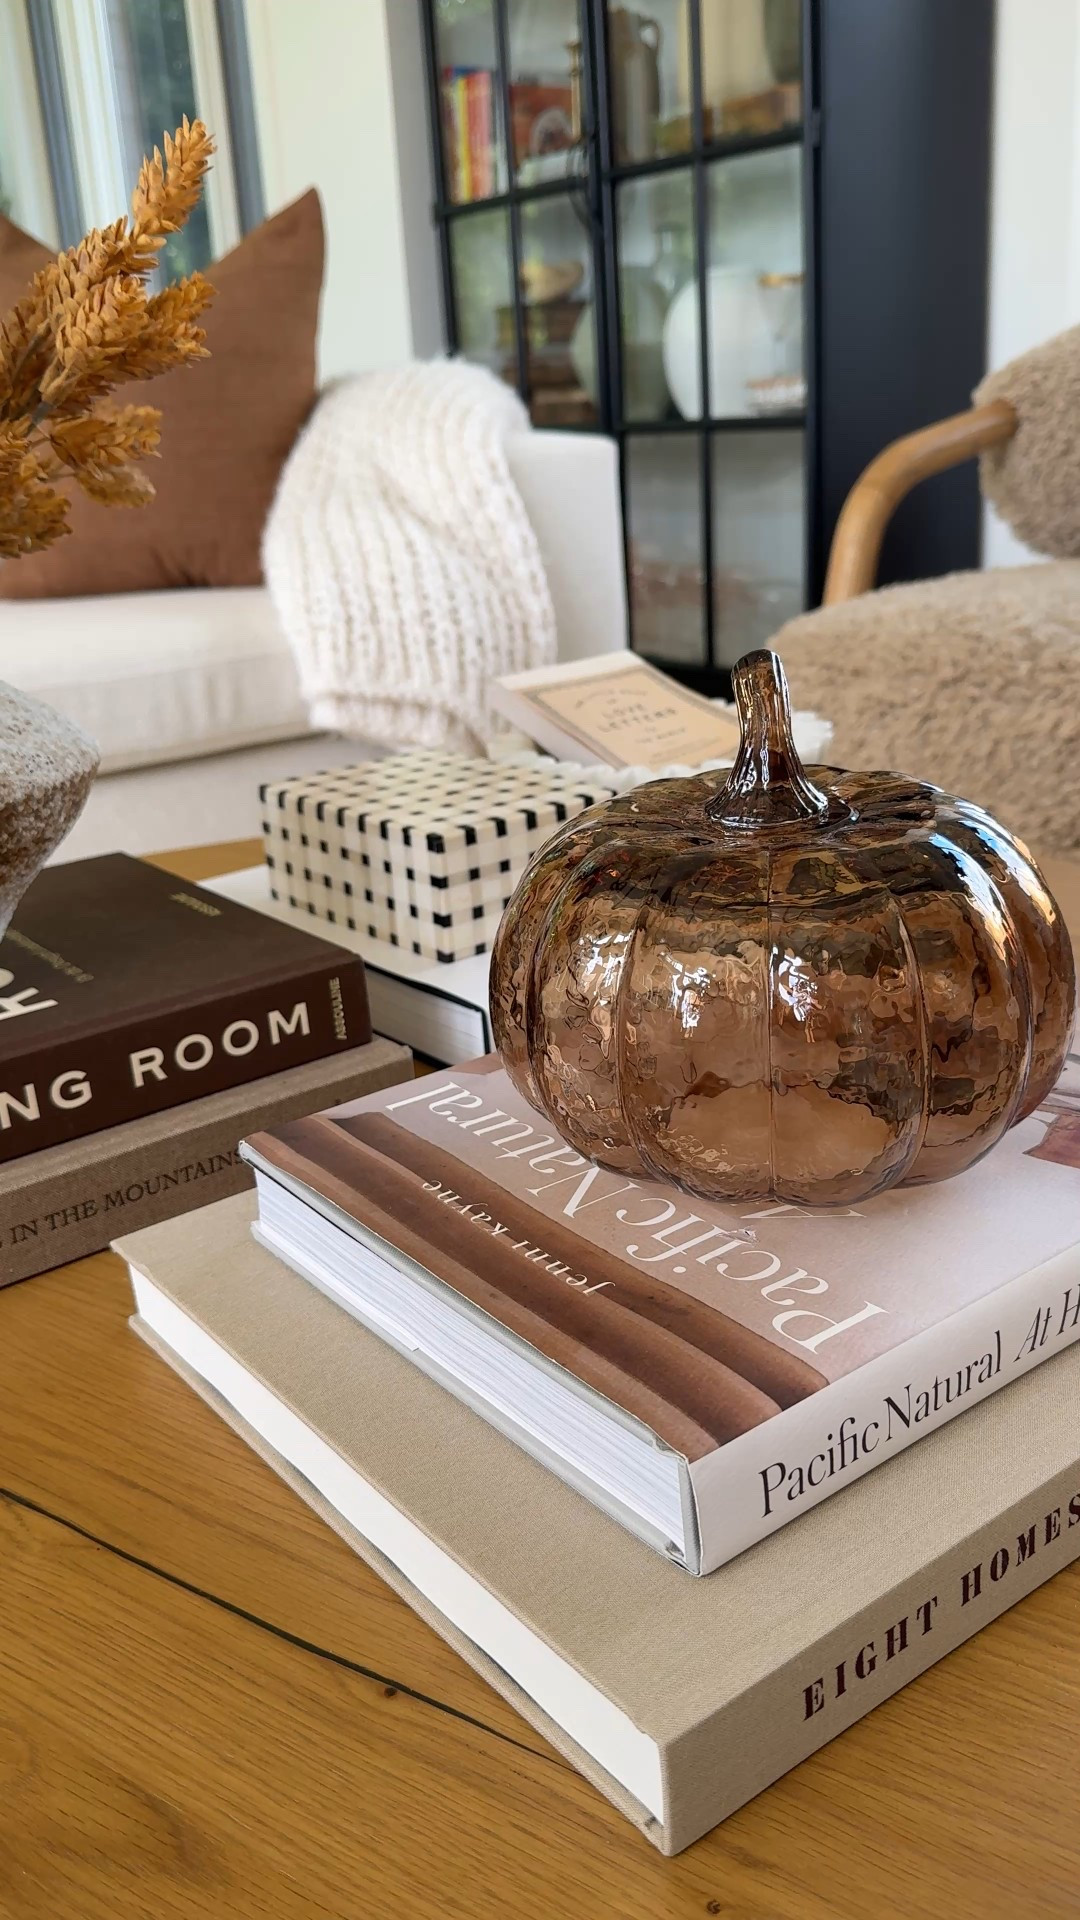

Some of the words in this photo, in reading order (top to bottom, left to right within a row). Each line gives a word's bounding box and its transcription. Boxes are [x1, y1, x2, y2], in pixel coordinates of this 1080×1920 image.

[0, 1070, 93, 1130] NG
[129, 1002, 311, 1089] ROOM
[10, 1219, 40, 1246] IN
[44, 1200, 100, 1231] THE
[104, 1151, 243, 1212] MOUNTAINS
[386, 1081, 642, 1221] Natural
[615, 1196, 889, 1356] Pacific
[758, 1416, 880, 1518] Pacific
[883, 1330, 1002, 1442] Natural
[1013, 1307, 1053, 1363] At
[802, 1596, 939, 1722] EIGHT
[960, 1492, 1080, 1608] HOMES
